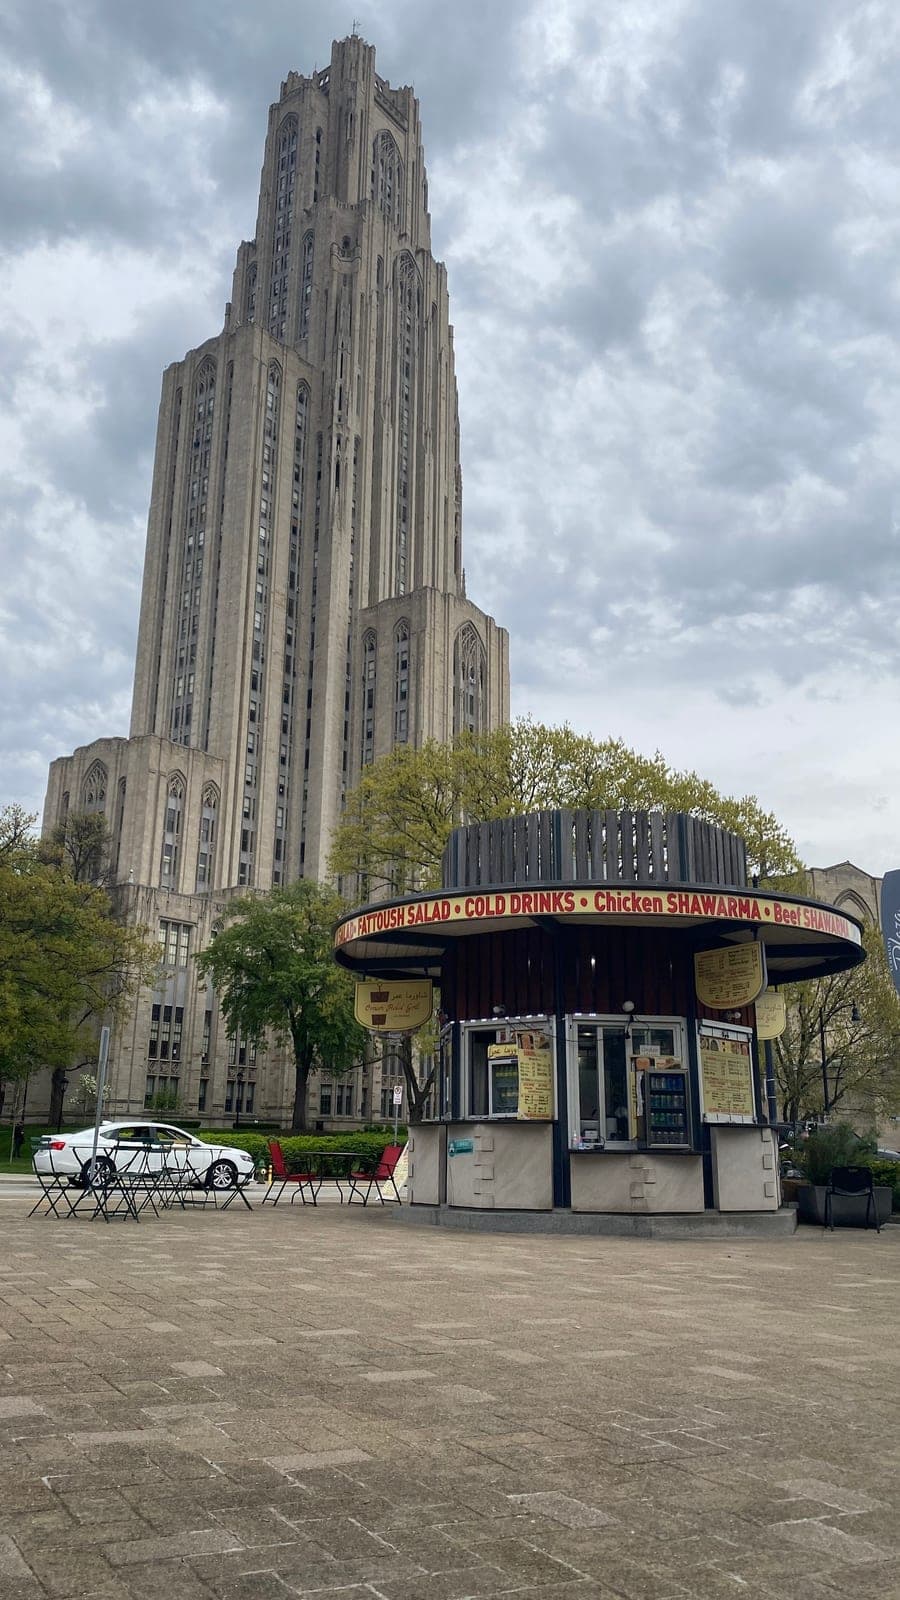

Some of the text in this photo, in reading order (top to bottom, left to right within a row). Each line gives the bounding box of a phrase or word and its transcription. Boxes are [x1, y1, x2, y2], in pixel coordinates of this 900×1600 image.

[357, 907, 405, 936] FATTOUSH
[407, 900, 451, 925] SALAD
[465, 895, 506, 917] COLD
[510, 891, 576, 914] DRINKS
[594, 891, 663, 913] Chicken
[667, 893, 762, 921] SHAWARMA
[773, 902, 802, 926] Beef
